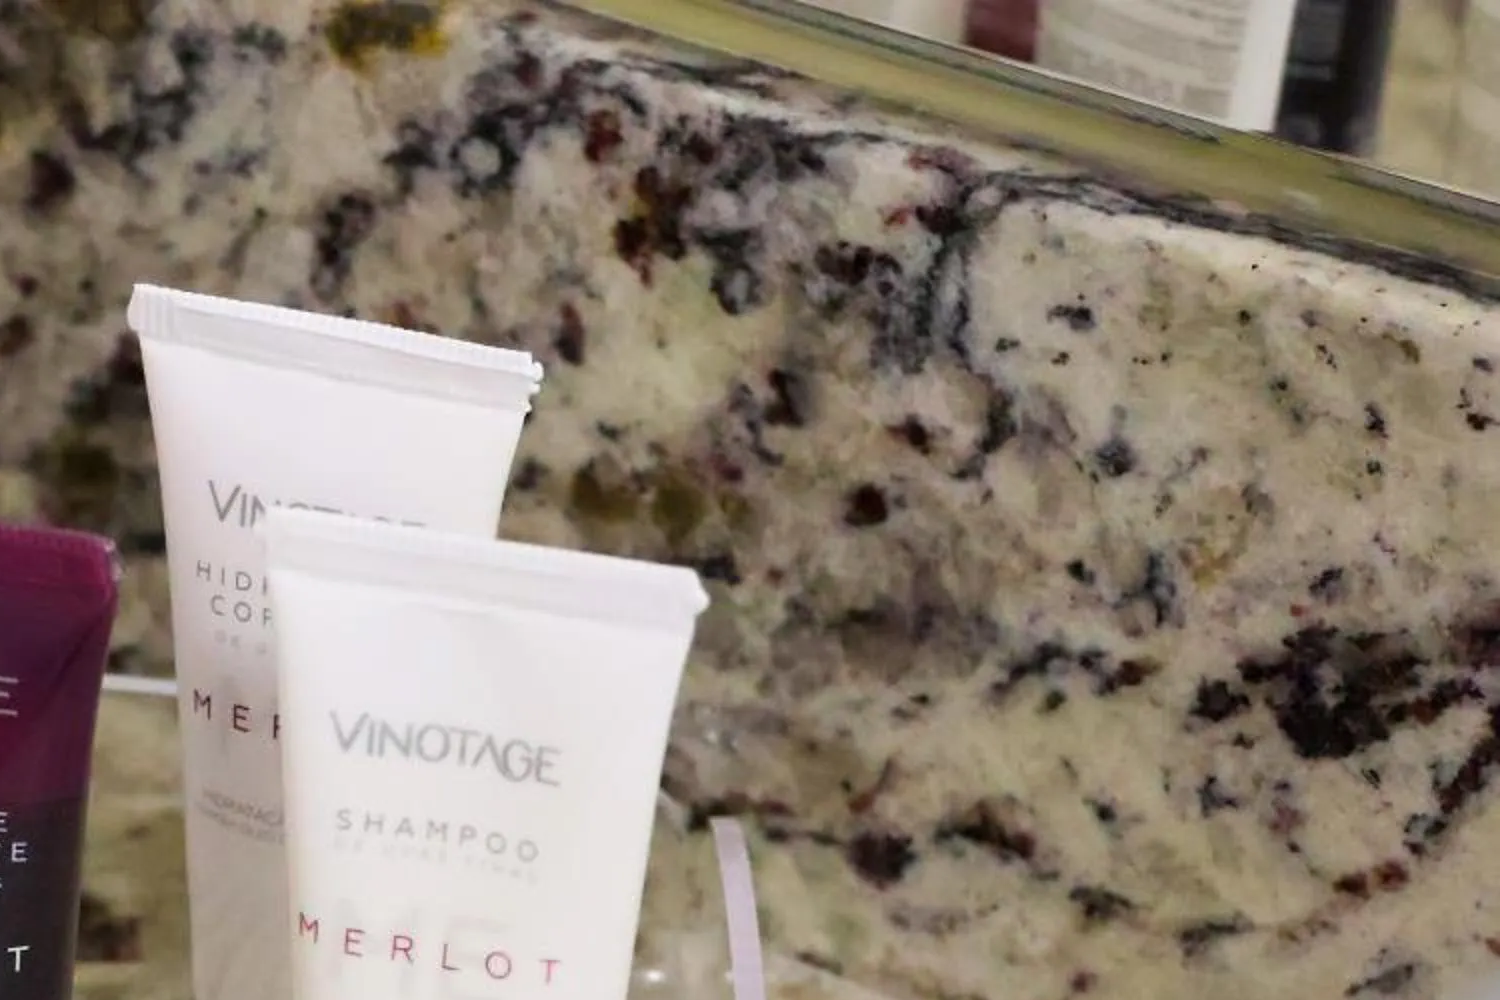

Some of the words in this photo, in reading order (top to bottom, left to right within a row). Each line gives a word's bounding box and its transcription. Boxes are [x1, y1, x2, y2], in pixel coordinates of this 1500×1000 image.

[329, 708, 563, 787] VINOTAGE
[336, 807, 540, 863] SHAMPOO
[298, 911, 562, 985] MERLOT
